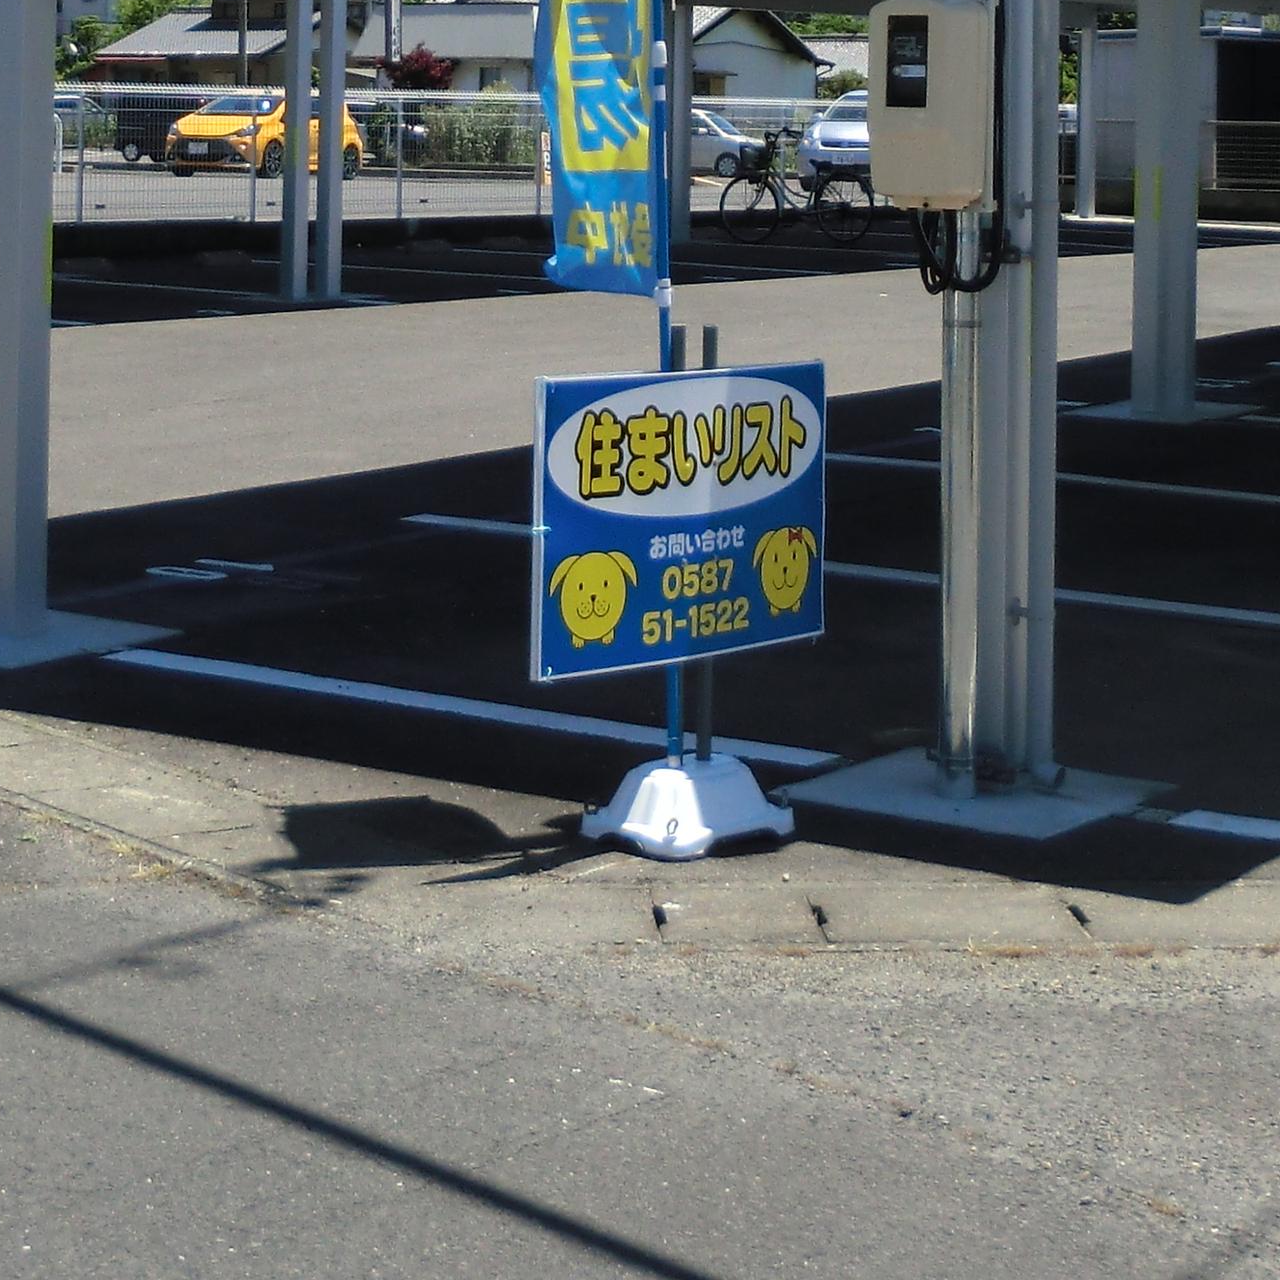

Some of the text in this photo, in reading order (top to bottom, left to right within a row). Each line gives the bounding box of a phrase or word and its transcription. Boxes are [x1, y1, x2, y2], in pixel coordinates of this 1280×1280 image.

[575, 394, 807, 501] 住まいリスト
[649, 525, 747, 561] お問い合わせ
[662, 558, 735, 600] 0587
[642, 596, 751, 646] 51-1522
